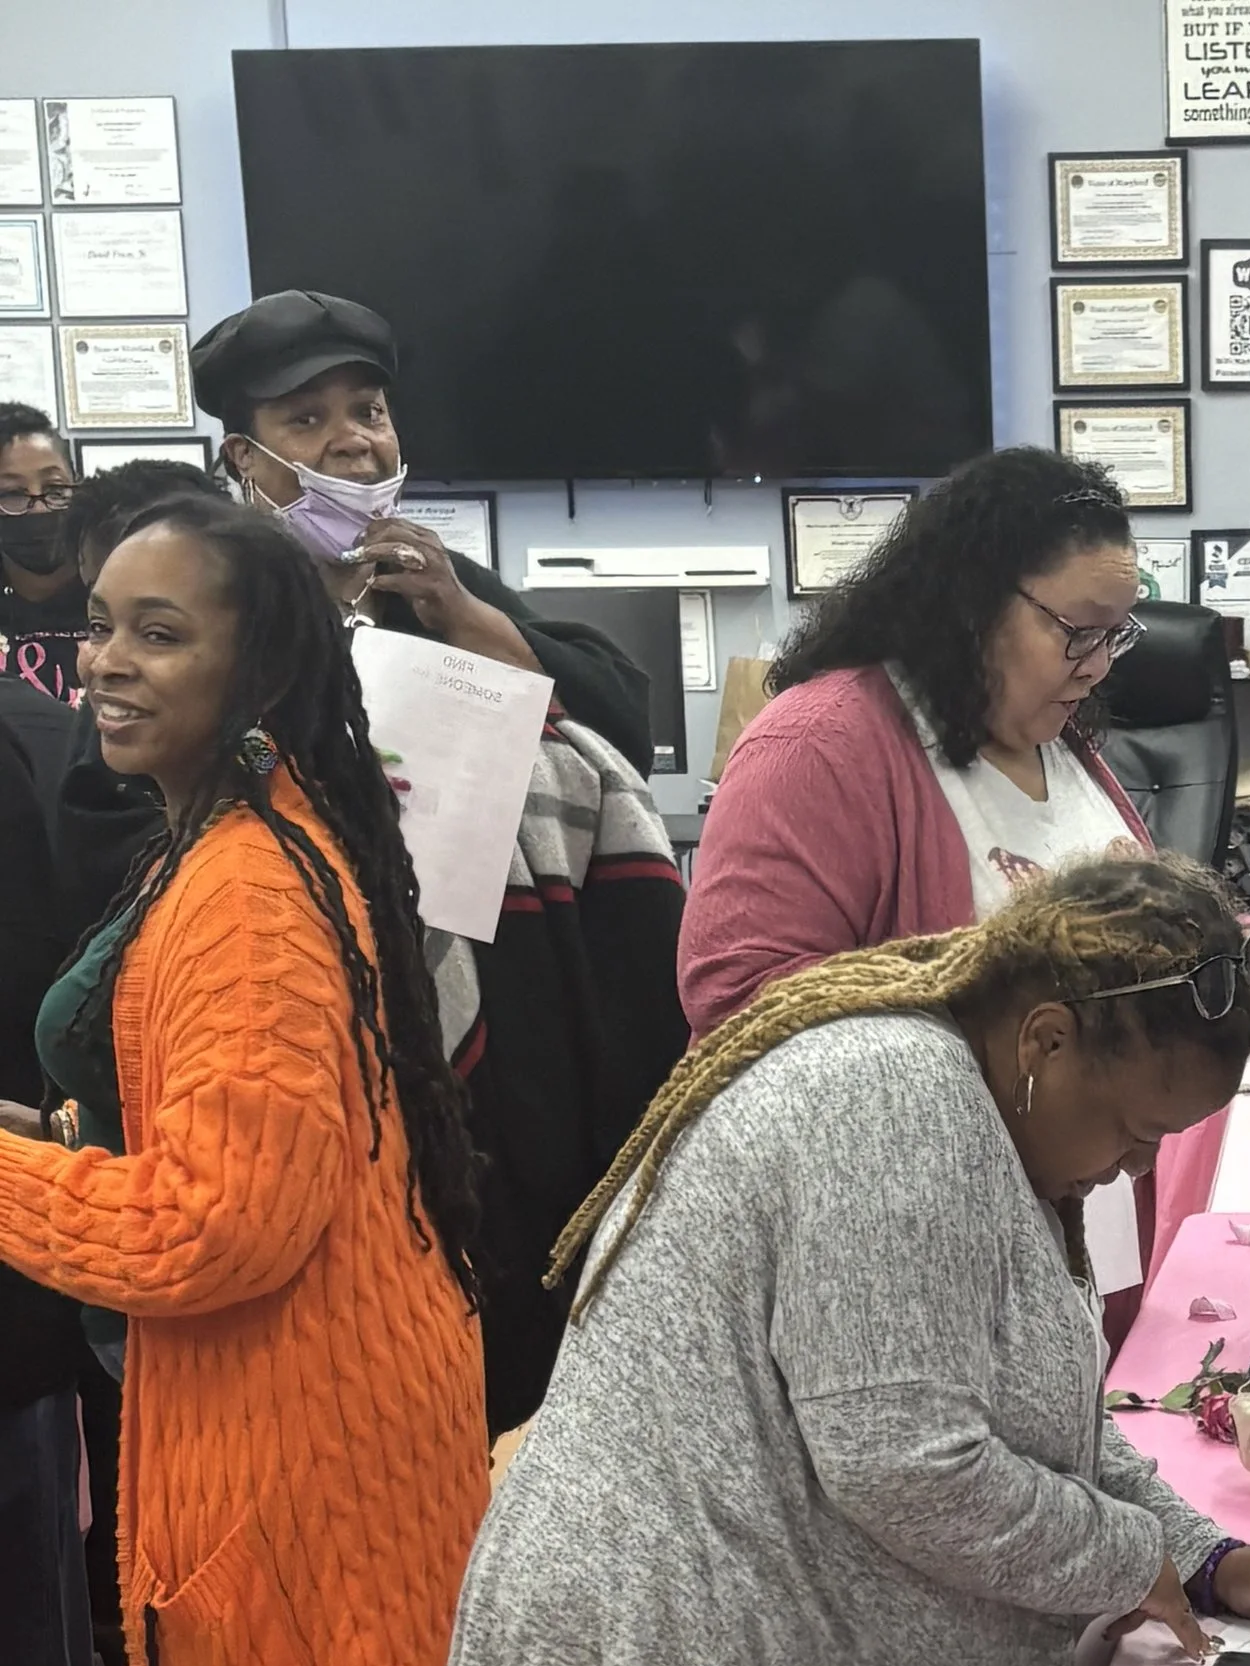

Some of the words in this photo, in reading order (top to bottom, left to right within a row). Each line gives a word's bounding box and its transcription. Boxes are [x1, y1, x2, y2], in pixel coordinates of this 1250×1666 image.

[1183, 22, 1219, 37] BUT
[1225, 22, 1243, 36] IF
[1201, 65, 1231, 78] you
